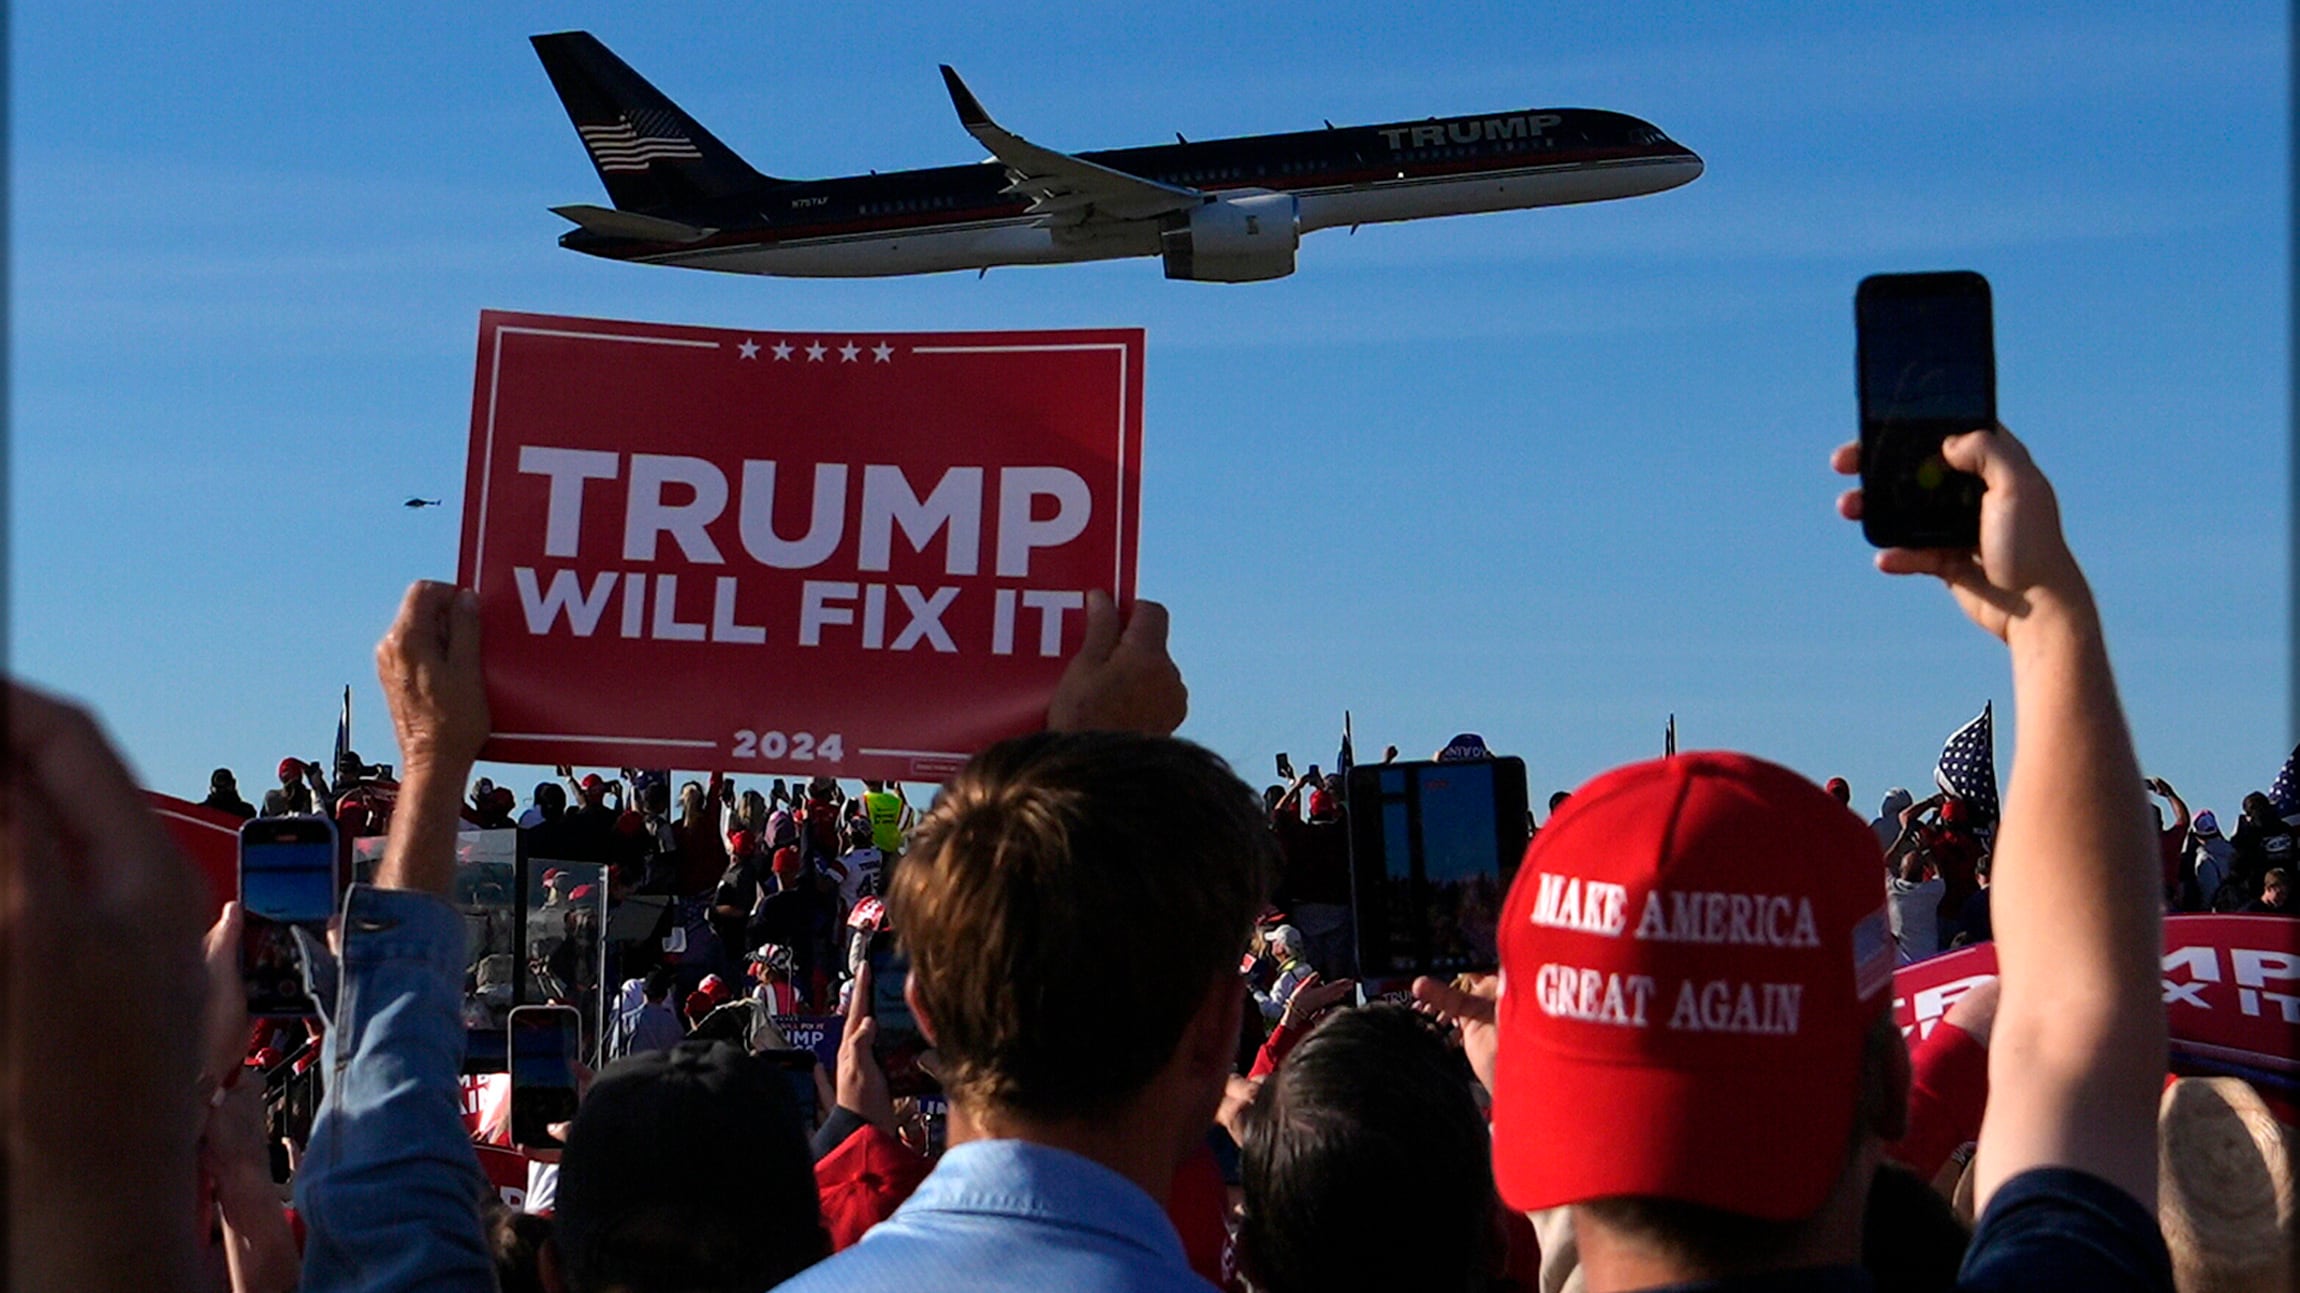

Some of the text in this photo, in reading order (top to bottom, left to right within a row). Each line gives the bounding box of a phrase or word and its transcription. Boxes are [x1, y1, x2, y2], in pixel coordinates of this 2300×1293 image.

[1378, 114, 1563, 150] TRUMP
[518, 445, 1092, 578] TRUMP
[513, 566, 1084, 657] WILL FIX IT
[732, 729, 844, 763] 2024
[1531, 872, 1821, 948] MAKE AMERICA
[1536, 962, 1803, 1035] GREAT AGAIN
